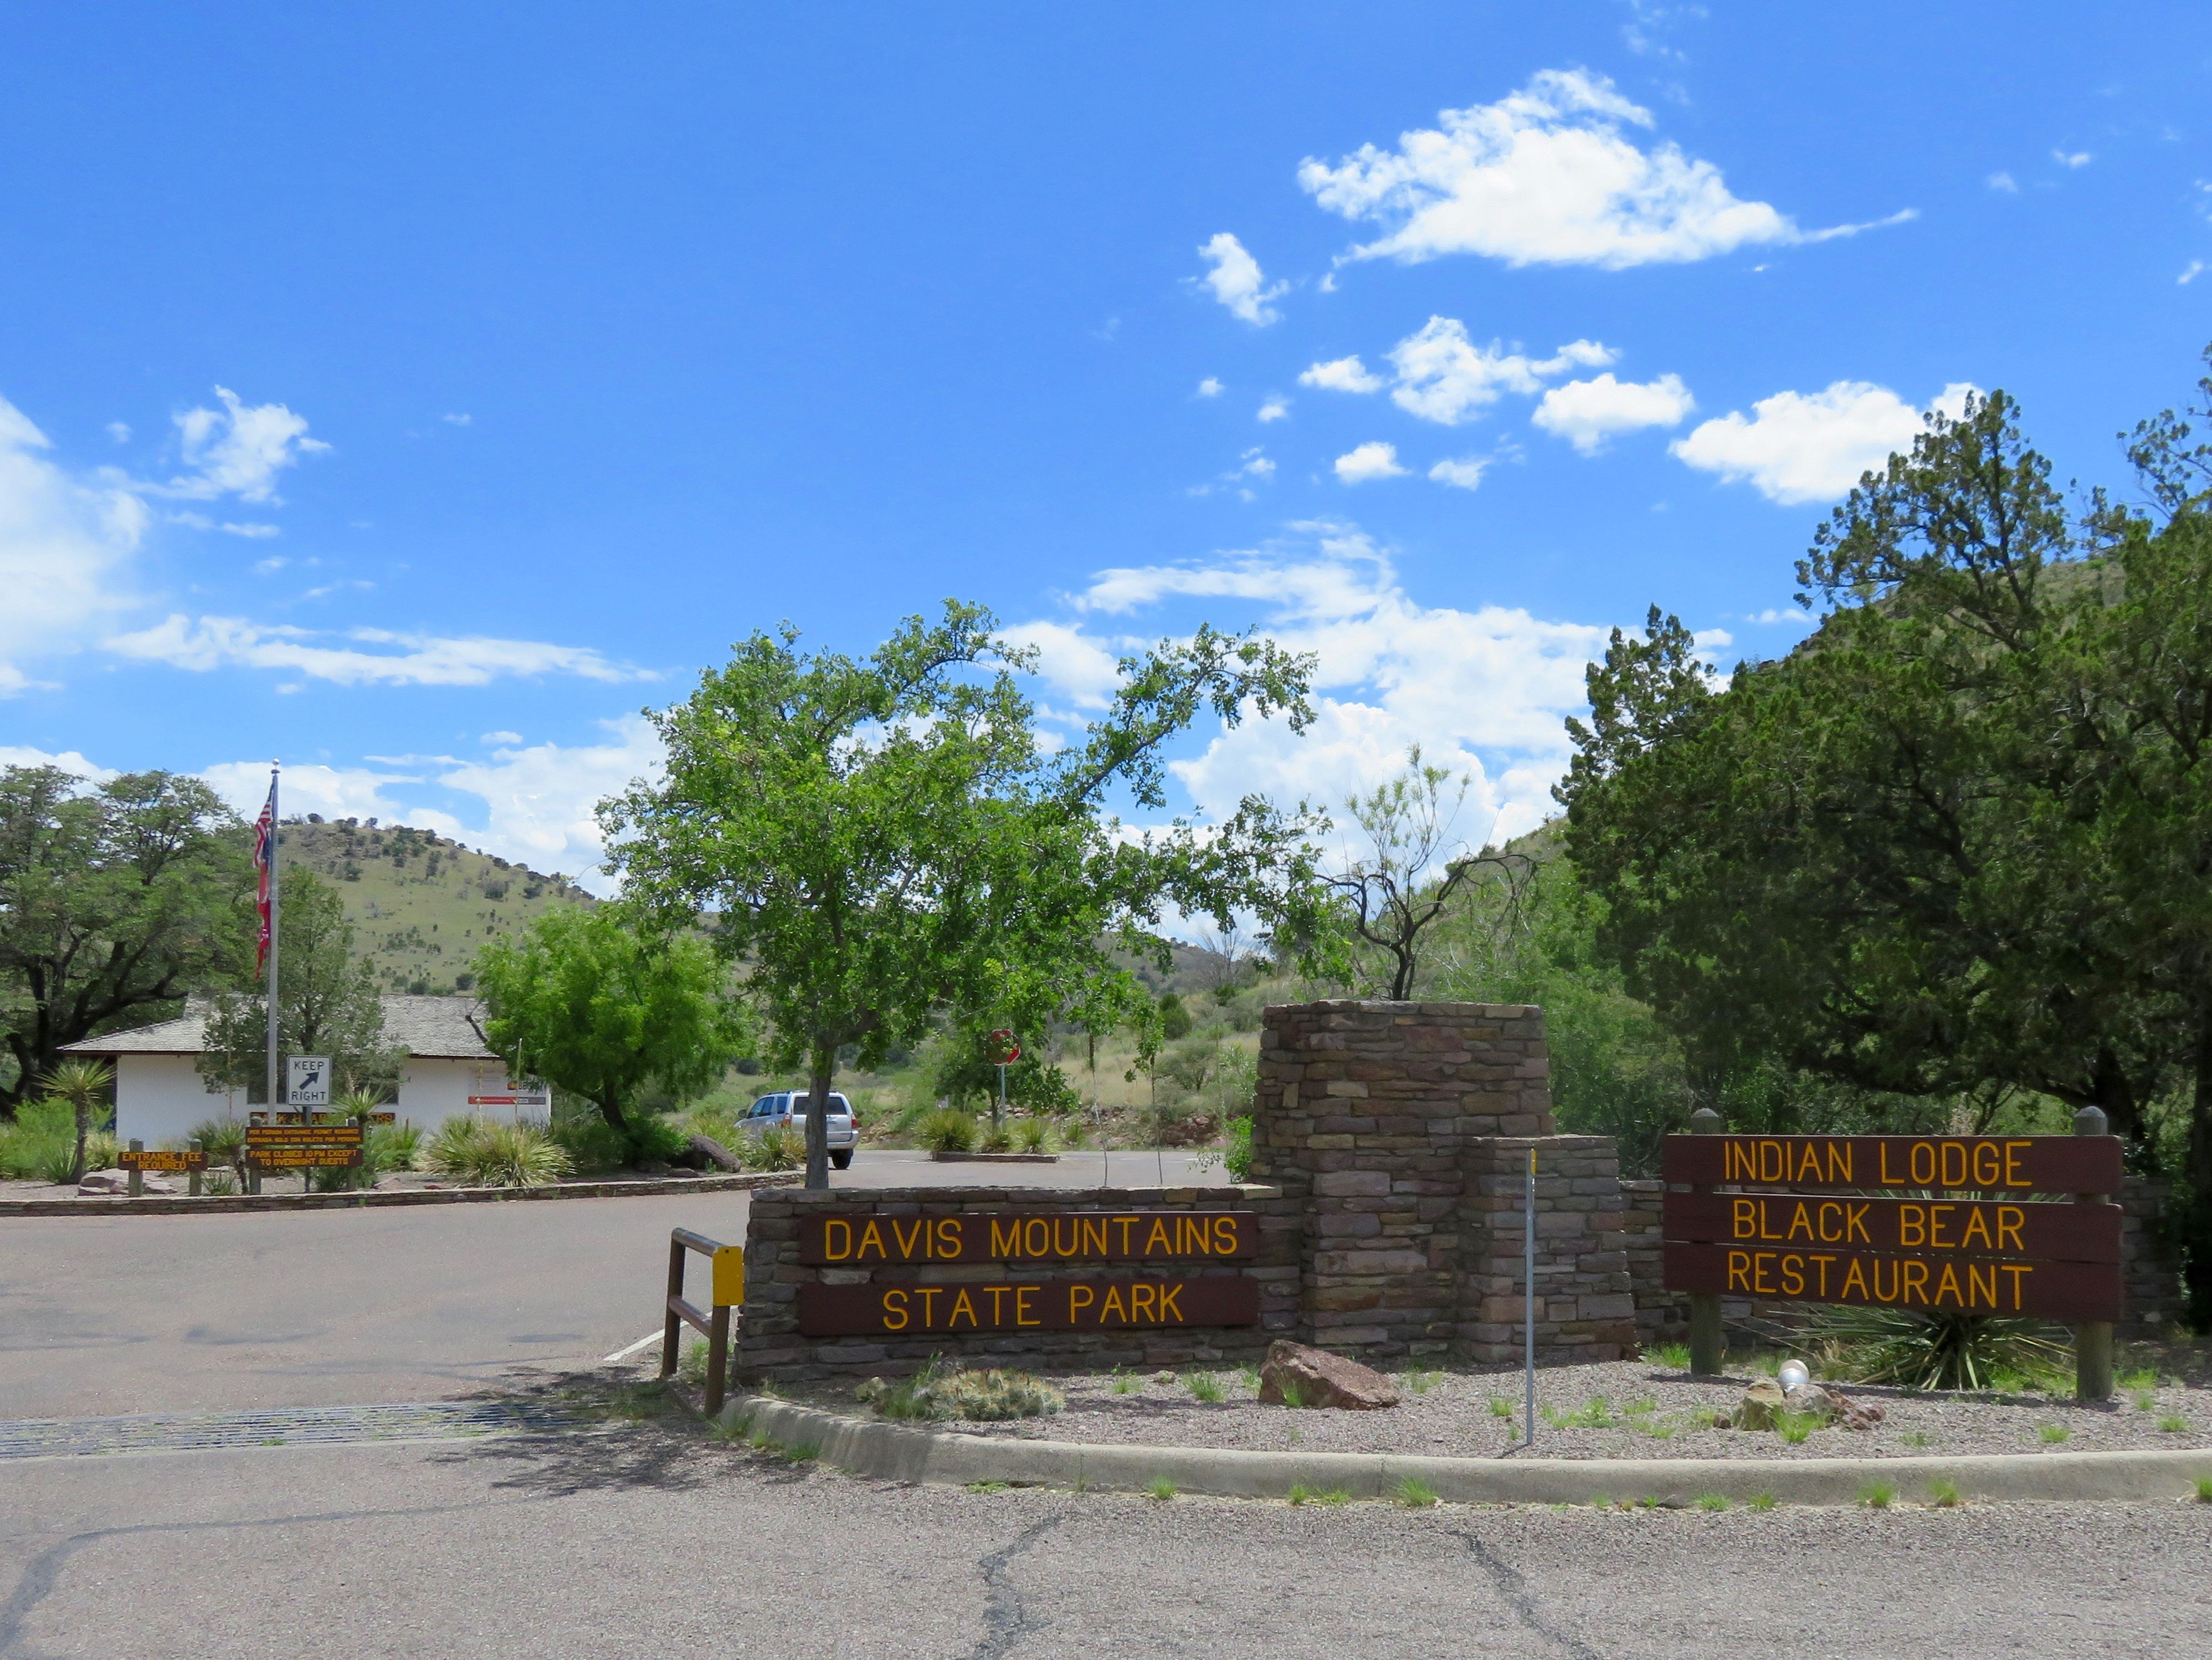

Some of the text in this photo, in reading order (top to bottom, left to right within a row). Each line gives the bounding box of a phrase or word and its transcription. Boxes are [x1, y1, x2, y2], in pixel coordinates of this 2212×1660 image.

[294, 1061, 324, 1070] KEEP
[291, 1091, 326, 1101] RIGHT
[122, 1152, 202, 1162] ENTRANCE FEE
[138, 1161, 187, 1170] REQUIRED
[1725, 1141, 2032, 1186] INDIAN LODGE
[824, 1217, 1238, 1259] DAVIS MOUNTAINS
[1733, 1200, 2025, 1250] BLACK BEAR
[1729, 1251, 2033, 1309] RESTAURANT
[883, 1284, 1183, 1330] STATE PARK
